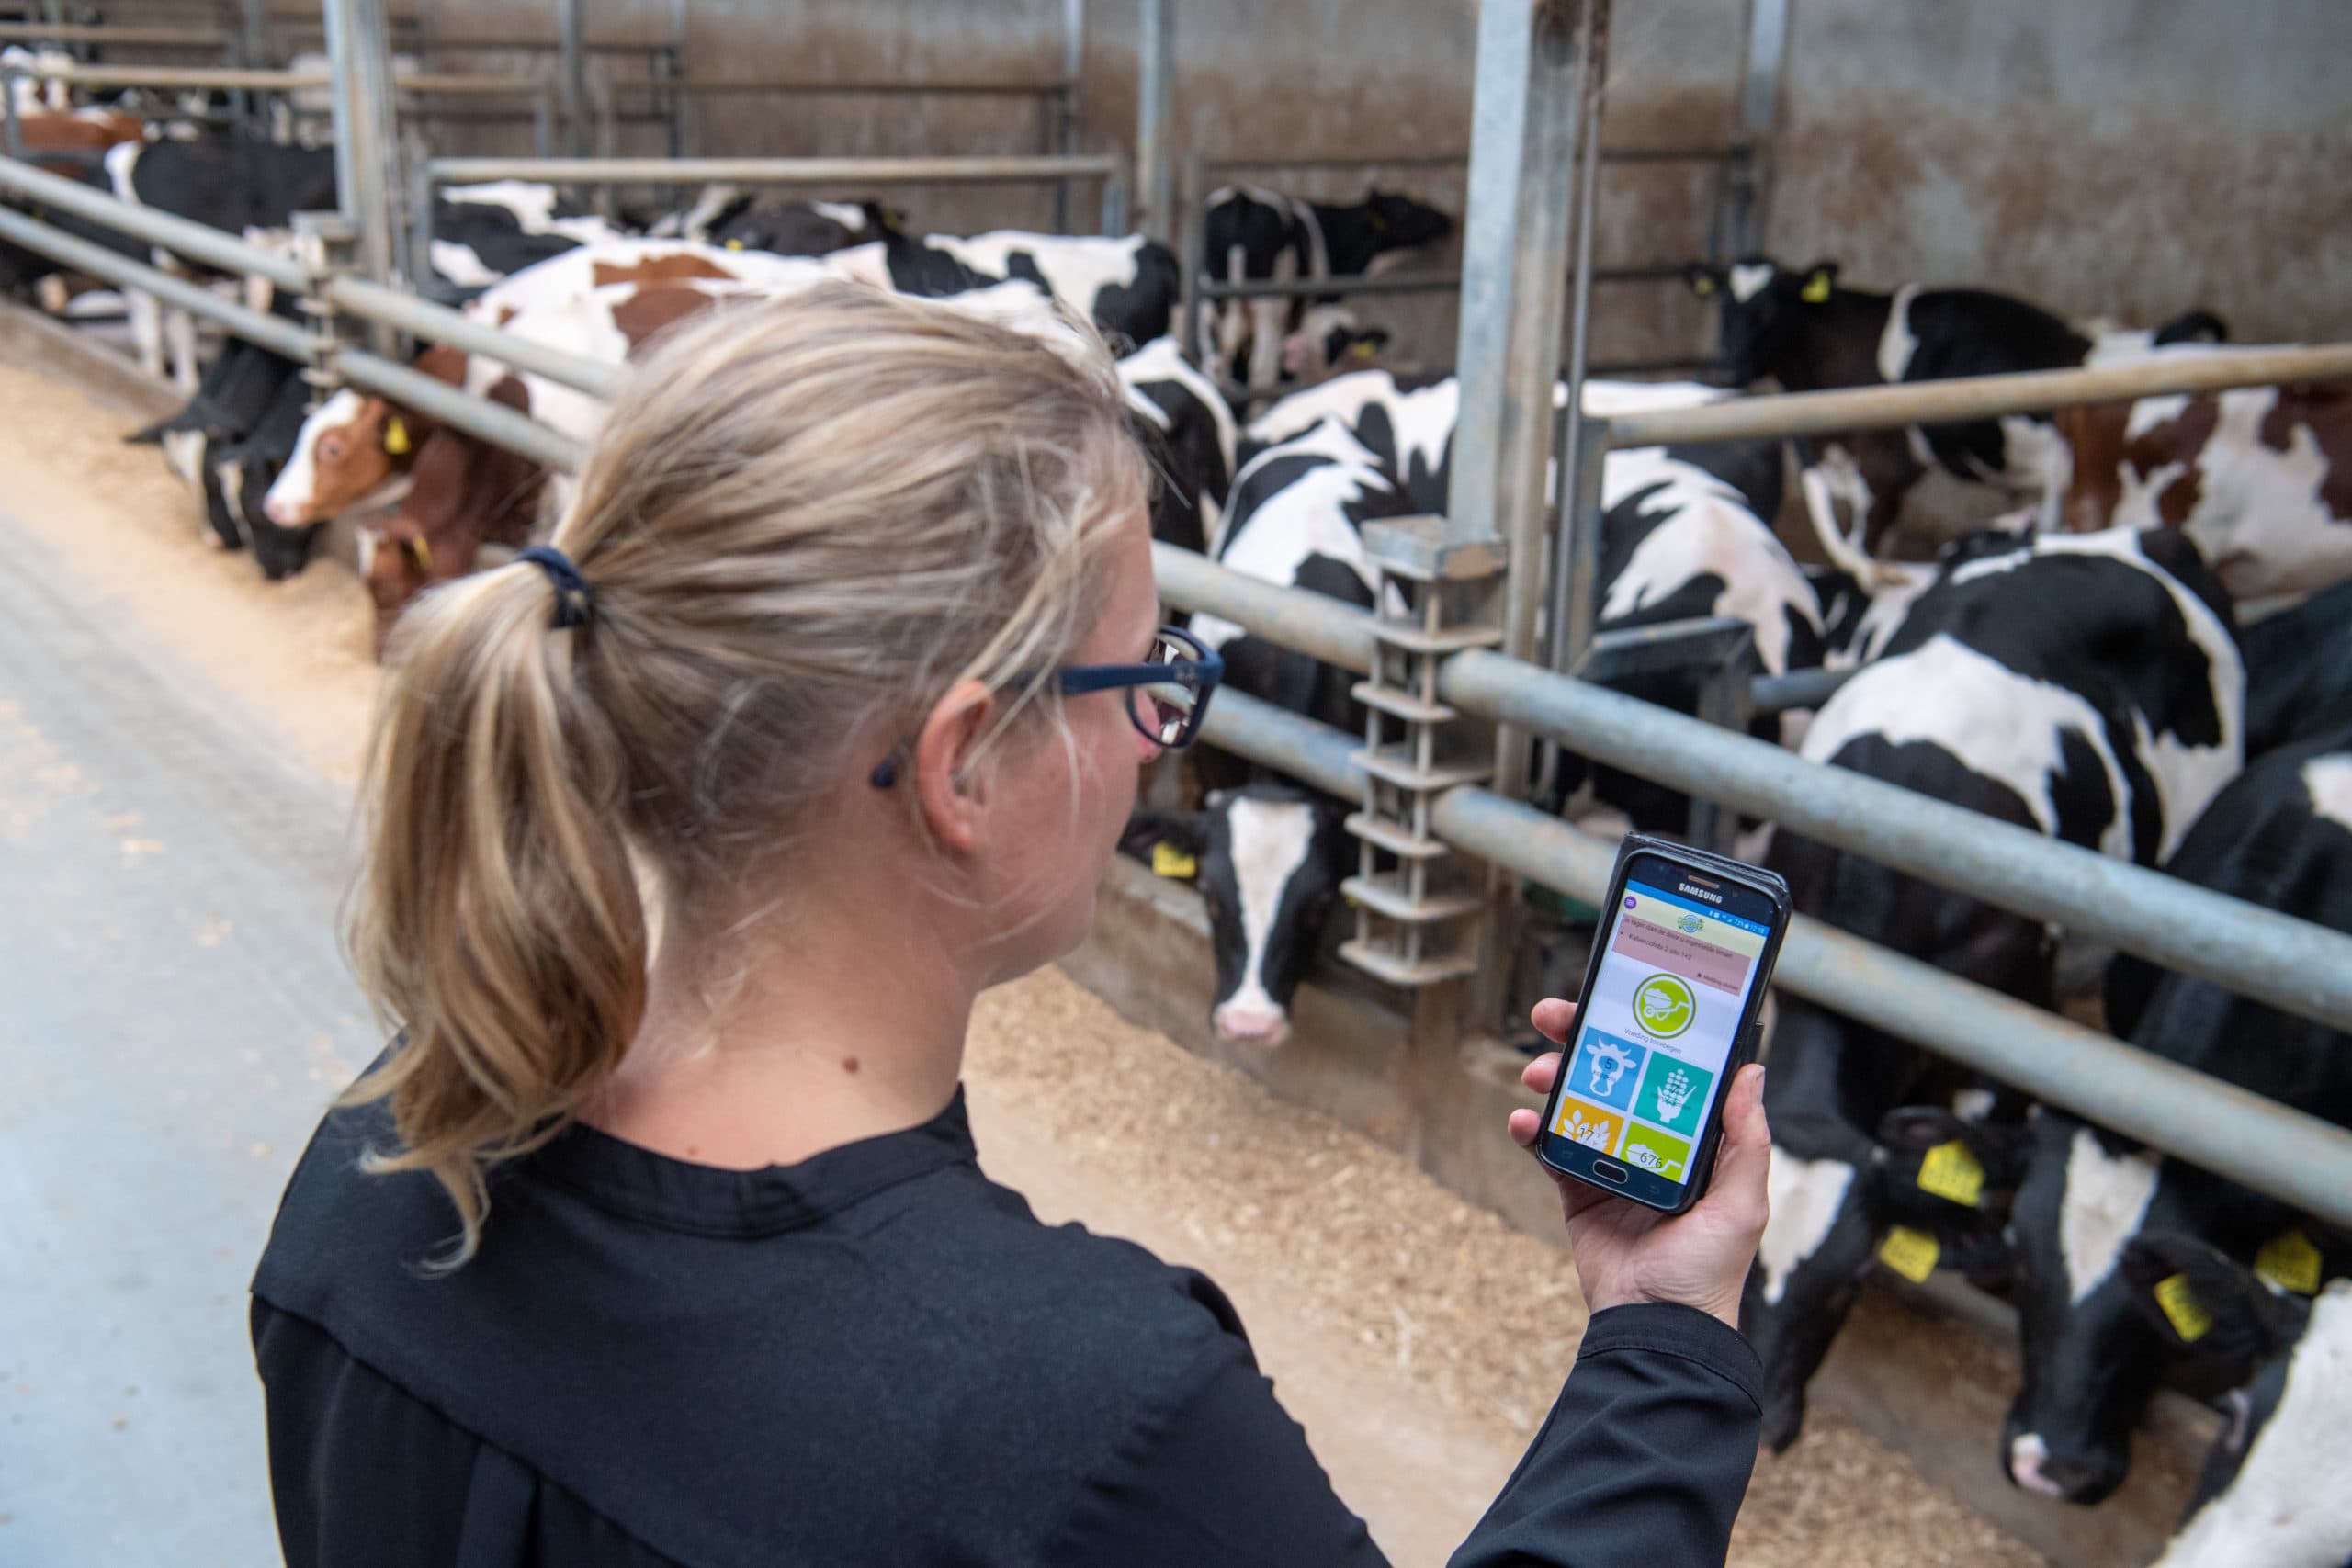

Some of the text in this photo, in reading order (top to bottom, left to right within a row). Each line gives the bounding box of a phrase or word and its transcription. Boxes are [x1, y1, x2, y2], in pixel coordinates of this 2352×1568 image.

[1679, 883, 1723, 904] SAMSUNG
[1624, 1028, 1681, 1054] Voeding toevoegen
[1604, 1057, 1614, 1070] 5
[1579, 1127, 1594, 1142] 17
[1640, 1151, 1664, 1168] 676
